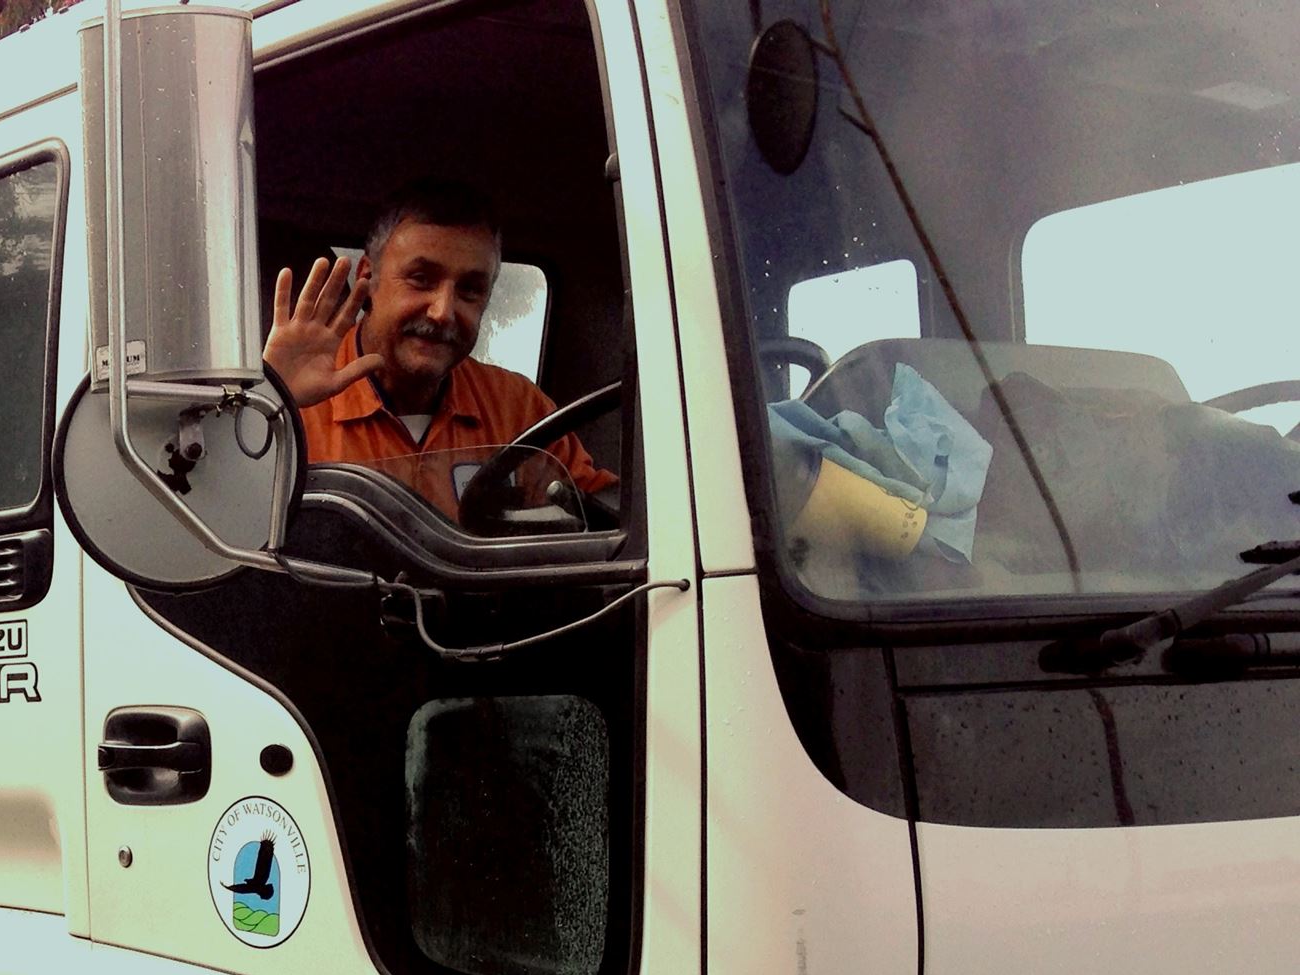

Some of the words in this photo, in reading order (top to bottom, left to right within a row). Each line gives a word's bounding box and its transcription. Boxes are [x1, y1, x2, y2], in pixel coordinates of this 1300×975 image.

[212, 824, 228, 862] CITY
[227, 810, 241, 827] OF
[242, 802, 307, 874] WATSONVILLE
